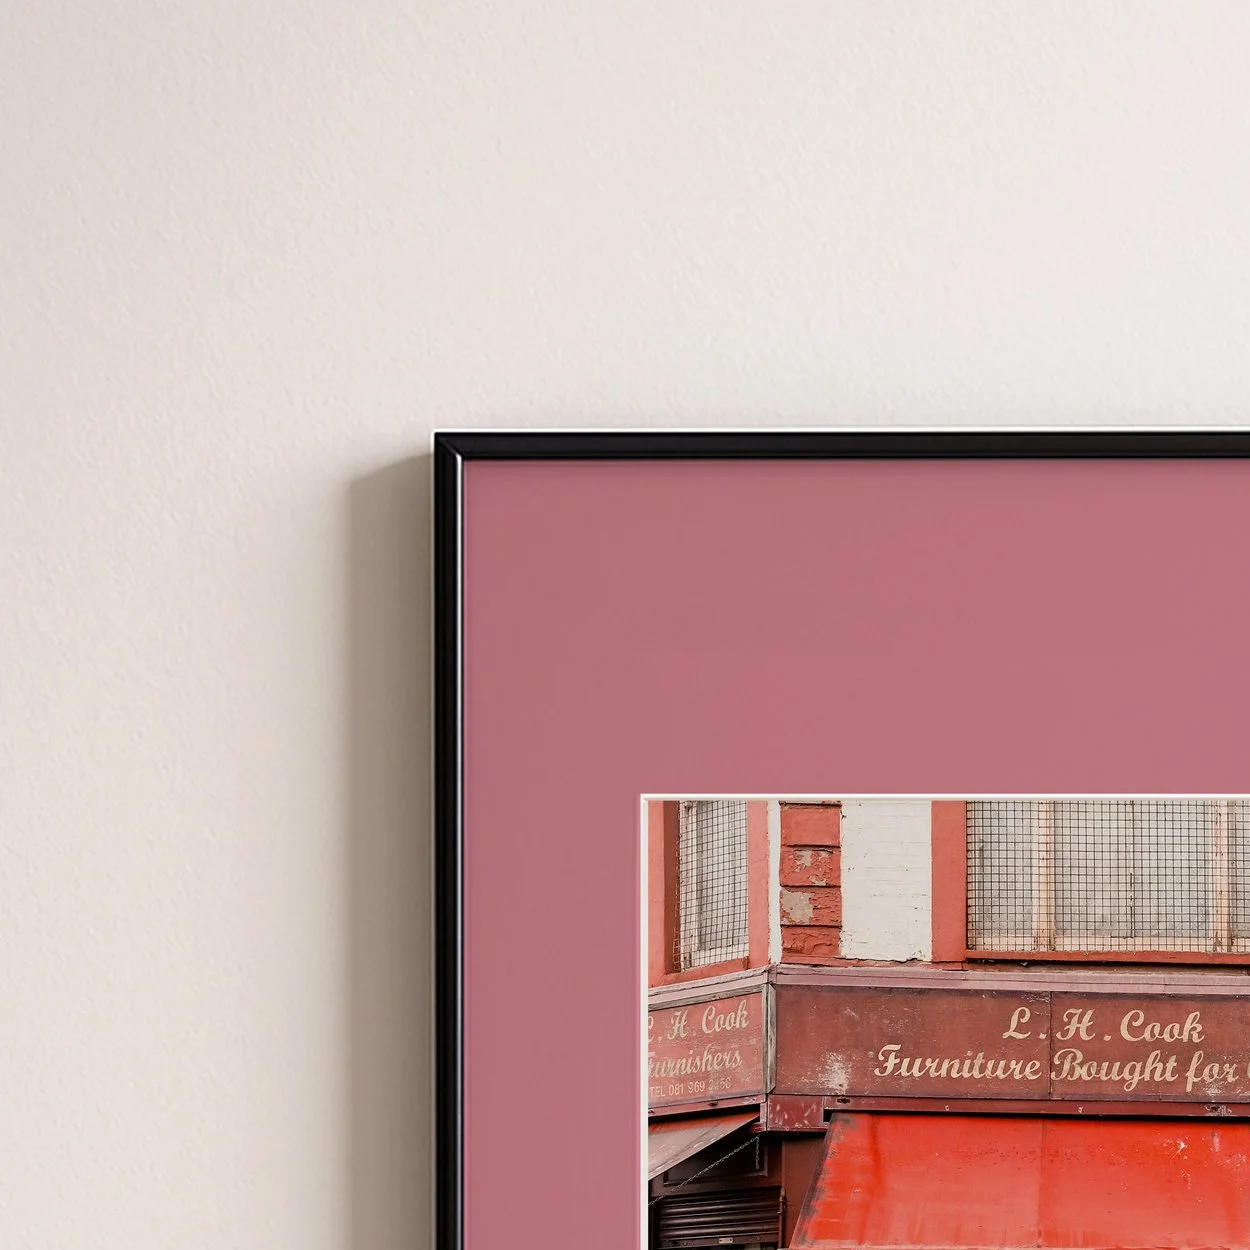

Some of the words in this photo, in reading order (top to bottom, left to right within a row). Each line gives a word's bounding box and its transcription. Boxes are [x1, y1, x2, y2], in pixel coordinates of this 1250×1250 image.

[701, 999, 750, 1034] Cook
[1120, 1009, 1205, 1043] Cook
[874, 1044, 1043, 1080] Furniture
[1050, 1048, 1179, 1092] Bought
[1185, 1050, 1240, 1092] for
[668, 1083, 684, 1096] 081
[688, 1080, 705, 1094] 969
